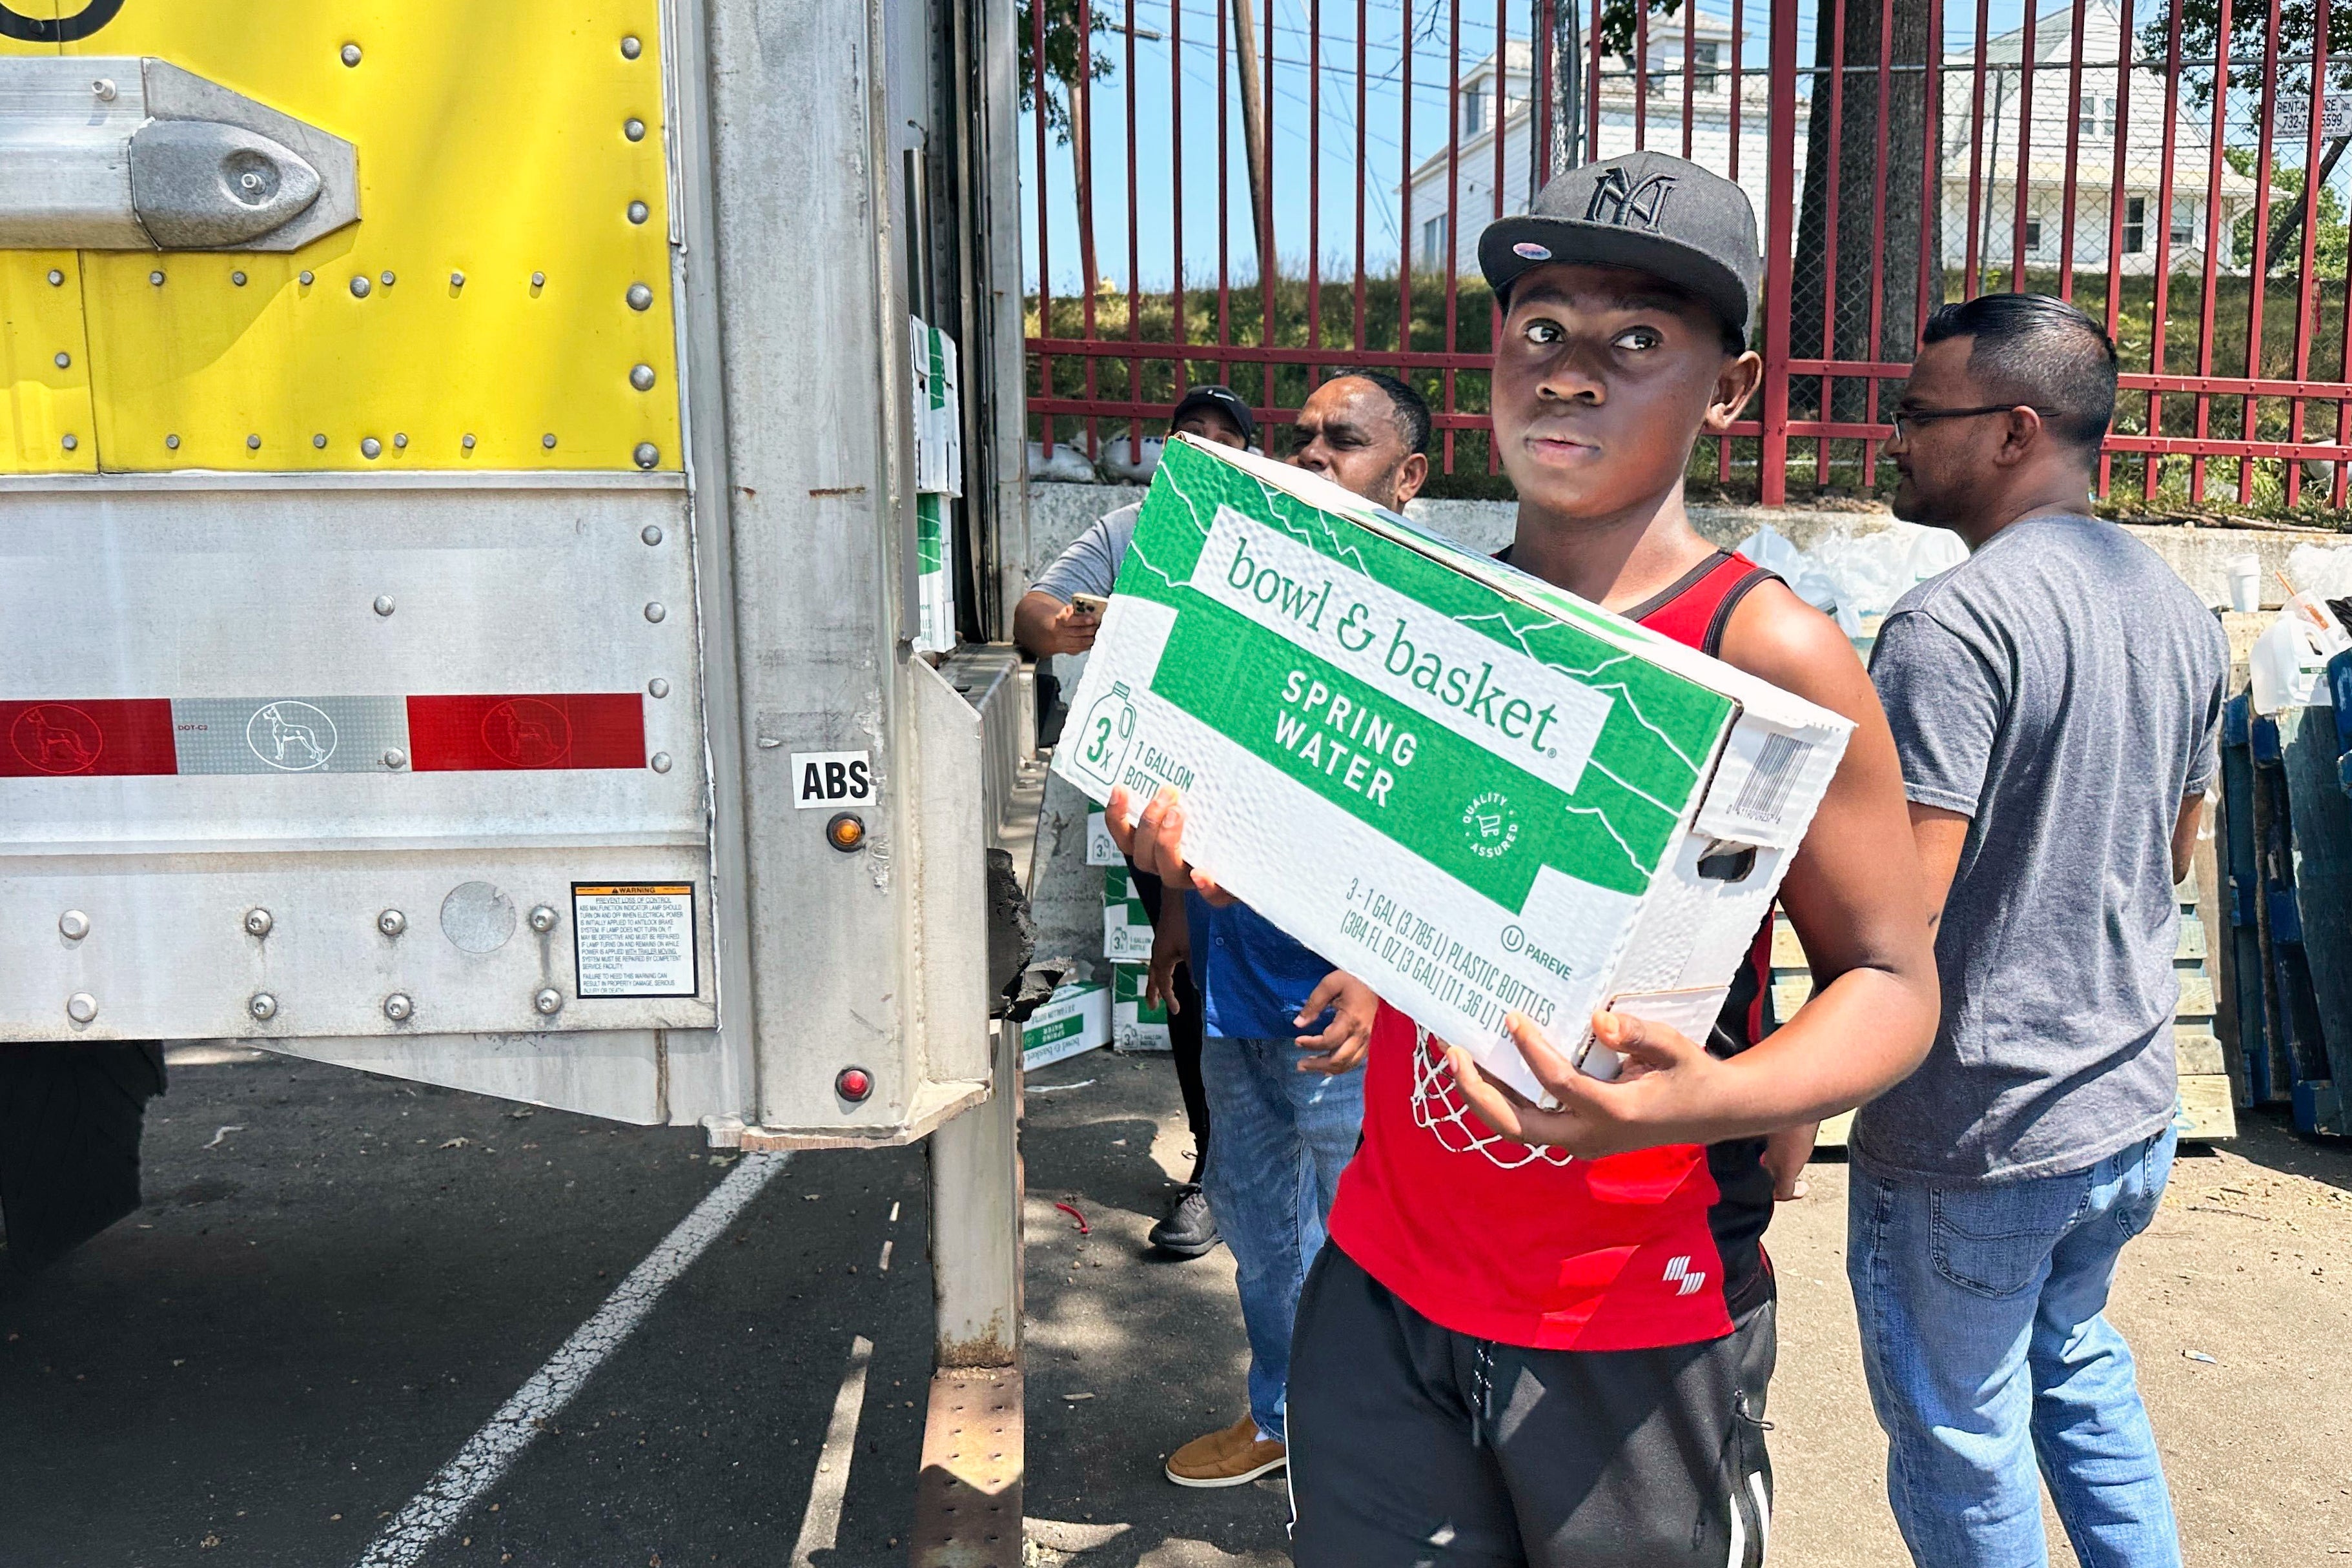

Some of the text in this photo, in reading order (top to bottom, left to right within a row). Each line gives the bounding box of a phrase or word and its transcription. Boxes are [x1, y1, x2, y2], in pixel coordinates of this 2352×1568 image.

[1584, 167, 1679, 234] NY
[1227, 536, 1331, 633] bowl
[1336, 603, 1376, 653] &
[1281, 669, 1417, 768] SPRING
[802, 760, 869, 800] ABS
[1135, 741, 1194, 793] 1 GALLON
[1274, 710, 1394, 808] WATER
[1462, 792, 1508, 823] QUALITY
[1470, 824, 1518, 857] ASSURED
[1340, 909, 1367, 943] (384
[1370, 933, 1382, 954] FL
[1382, 937, 1402, 964] OZ
[1396, 945, 1415, 972] [3
[1412, 957, 1444, 995] GAL]
[1440, 974, 1480, 1018] [11.36
[1480, 1000, 1497, 1030] L]
[1346, 877, 1358, 900] 3
[1364, 888, 1374, 911] 1
[1373, 895, 1397, 927] GAL
[1395, 909, 1437, 953] (3.785
[1433, 933, 1448, 961] L)
[1447, 942, 1497, 991] PLASTIC
[1495, 973, 1555, 1026] BOTTLES
[1525, 943, 1573, 981] PAREVE
